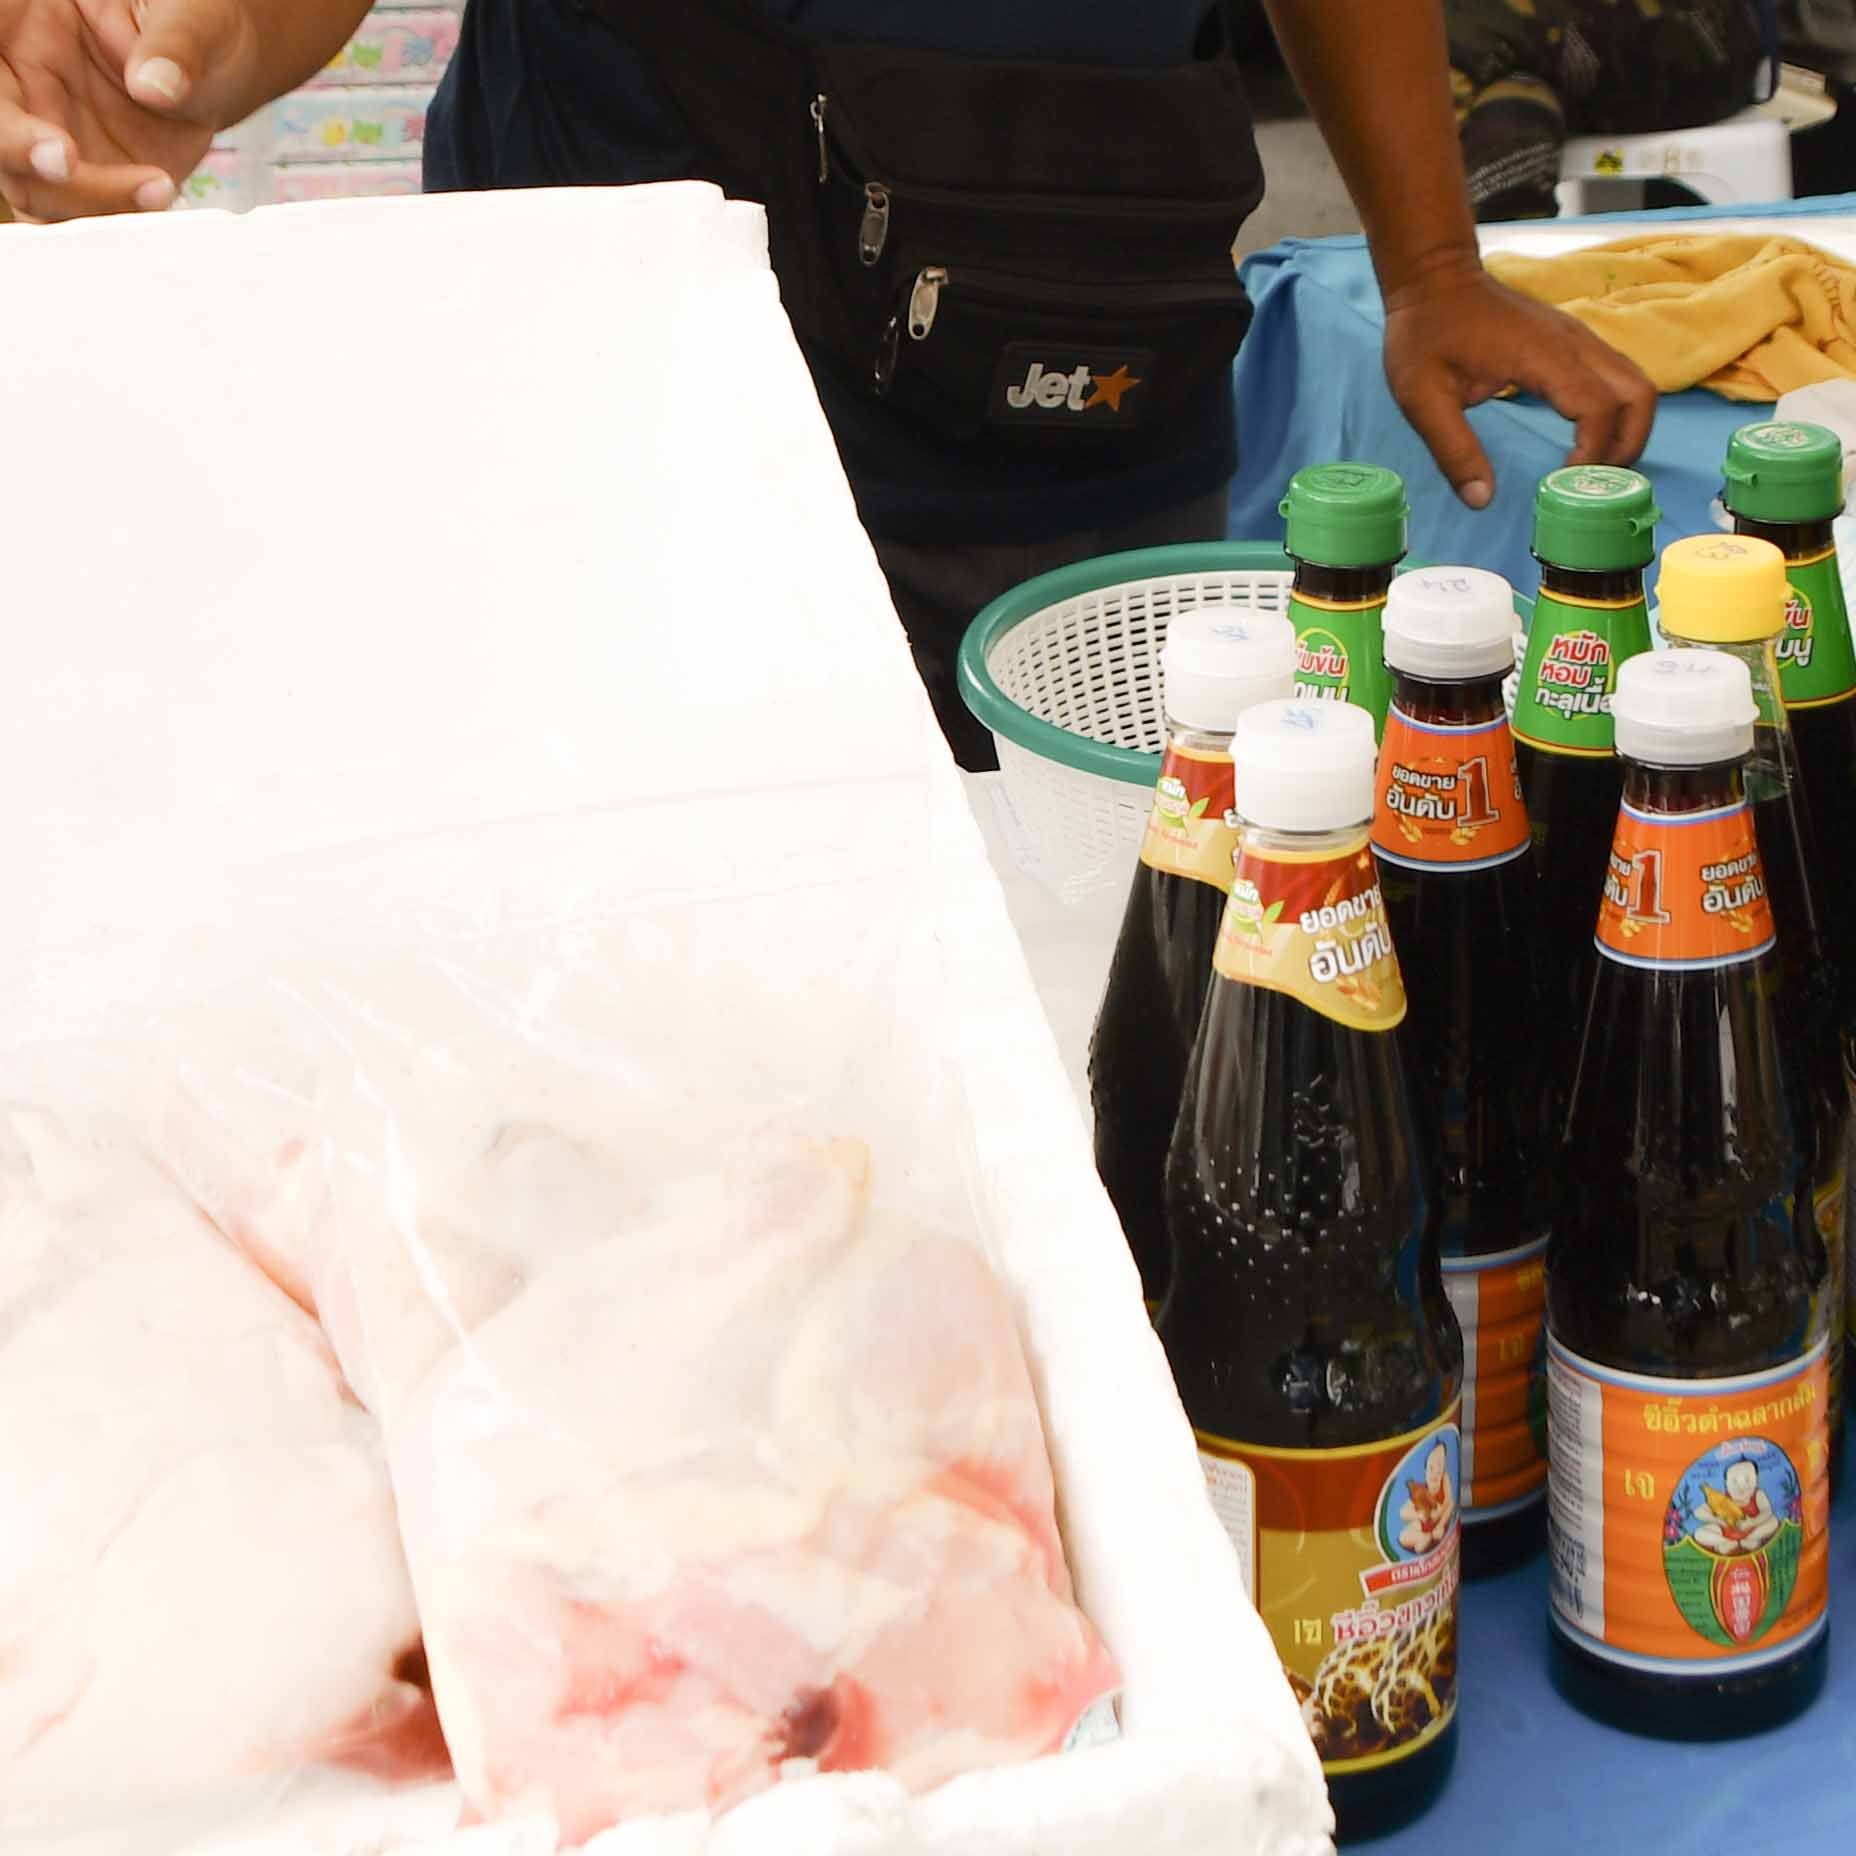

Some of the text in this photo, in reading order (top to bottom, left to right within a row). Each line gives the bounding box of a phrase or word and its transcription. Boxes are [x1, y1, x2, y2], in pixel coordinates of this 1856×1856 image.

[1007, 362, 1090, 411] Jet
[1550, 630, 1611, 665] หมัก
[1539, 660, 1593, 688] หอม
[1386, 755, 1500, 828] อันดับ 1
[1392, 764, 1457, 790] ยอดขาย
[1627, 848, 1672, 924] 1
[1310, 920, 1392, 983] อันดับ
